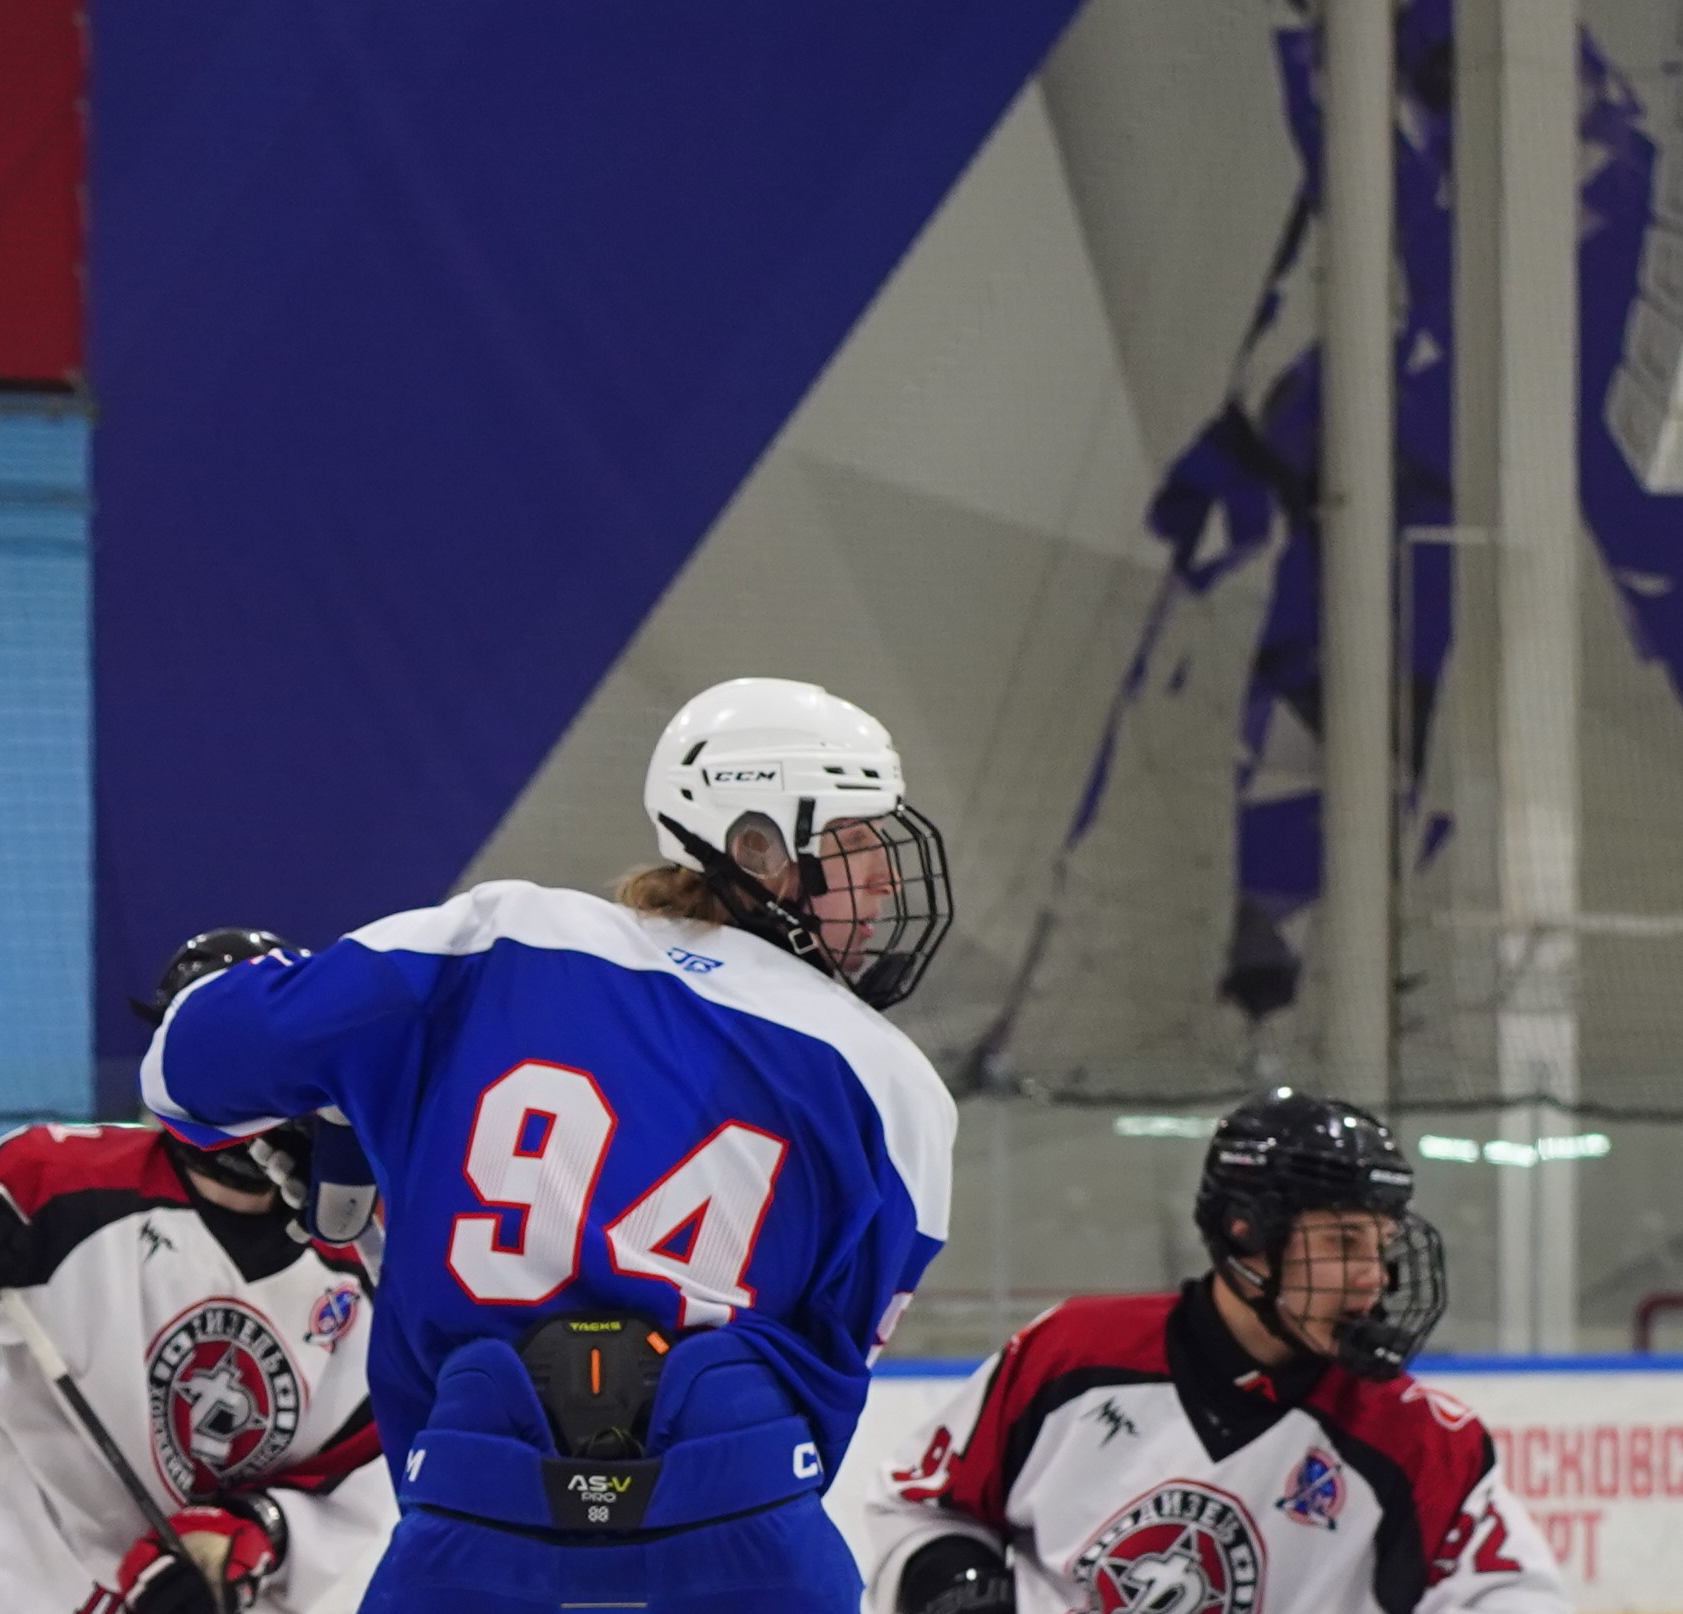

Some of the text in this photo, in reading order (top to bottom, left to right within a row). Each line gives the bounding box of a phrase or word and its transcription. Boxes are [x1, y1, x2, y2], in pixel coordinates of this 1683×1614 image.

[714, 769, 777, 783] CCM
[446, 1058, 790, 1332] 94
[567, 1474, 632, 1493] AS-V
[581, 1491, 617, 1503] PRO
